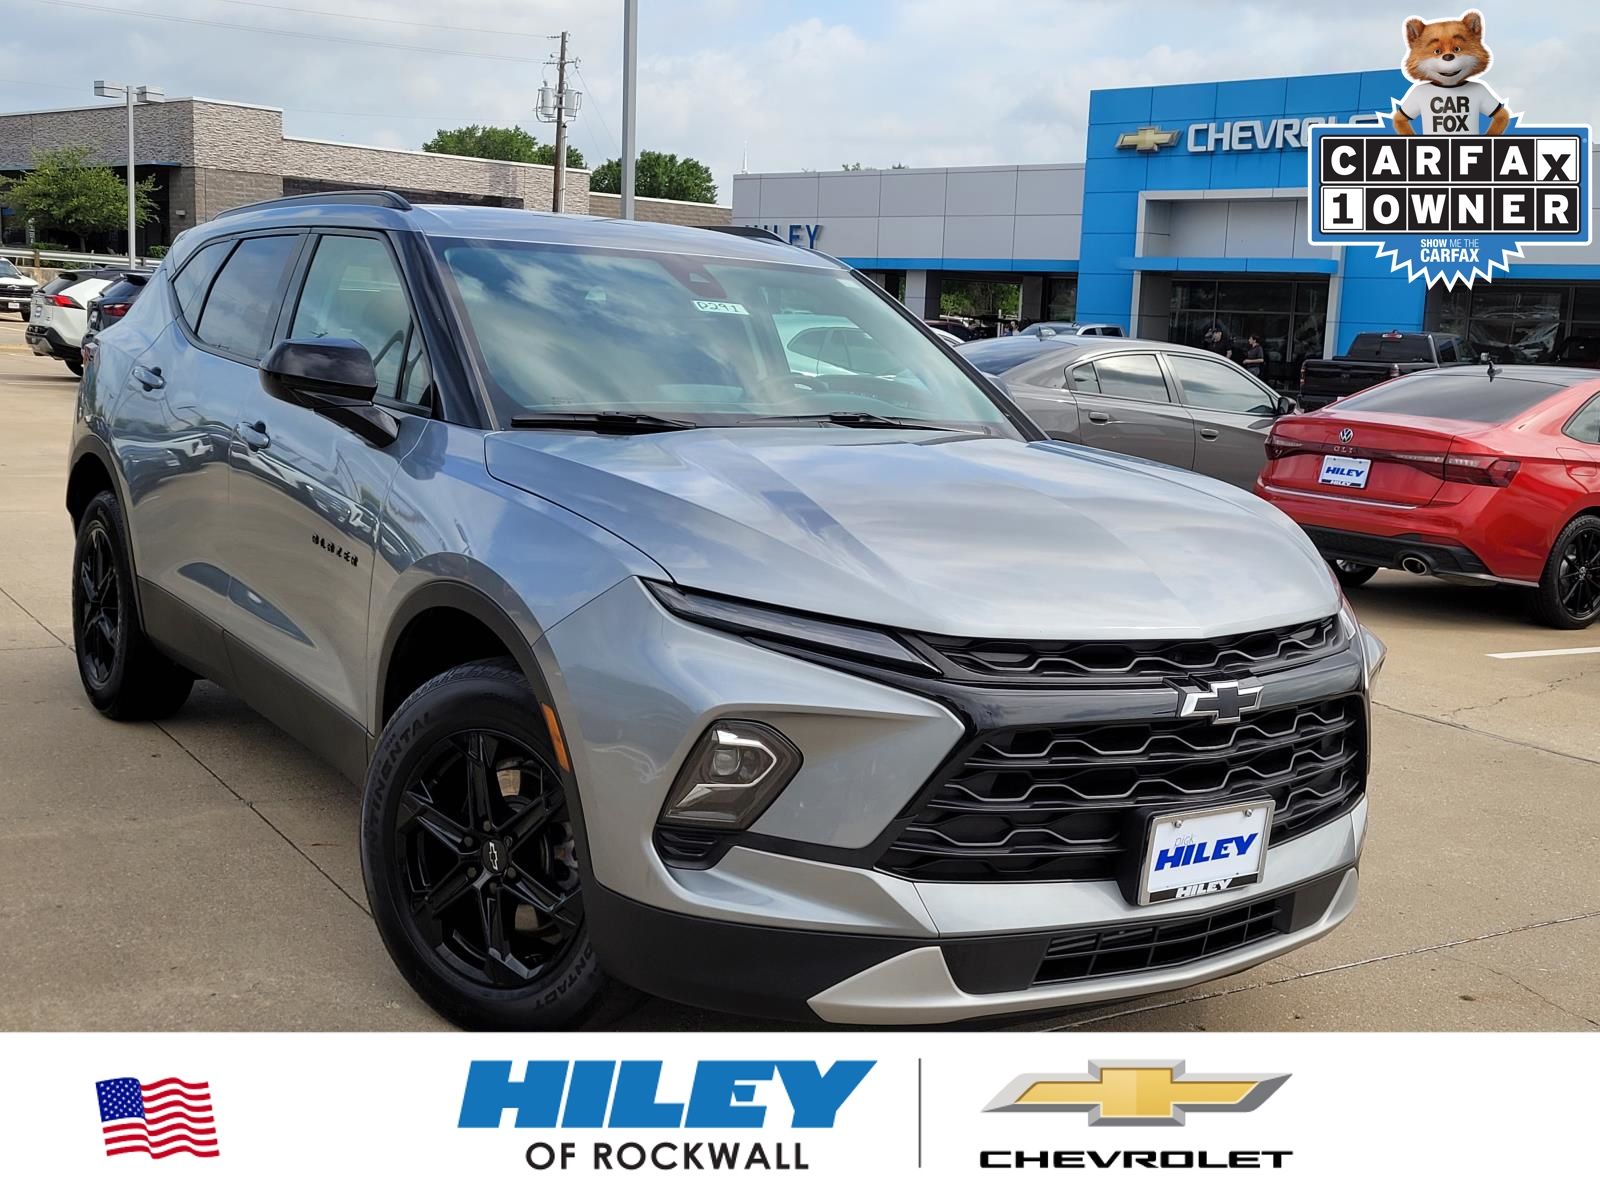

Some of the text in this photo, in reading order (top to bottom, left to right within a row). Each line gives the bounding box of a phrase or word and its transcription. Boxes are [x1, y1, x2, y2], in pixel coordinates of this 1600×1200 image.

[1187, 113, 1380, 153] CHEVRO
[1325, 466, 1365, 478] HILEY
[312, 534, 359, 567] BLAZER
[1154, 832, 1259, 872] HILEY
[1175, 878, 1233, 899] HILEY
